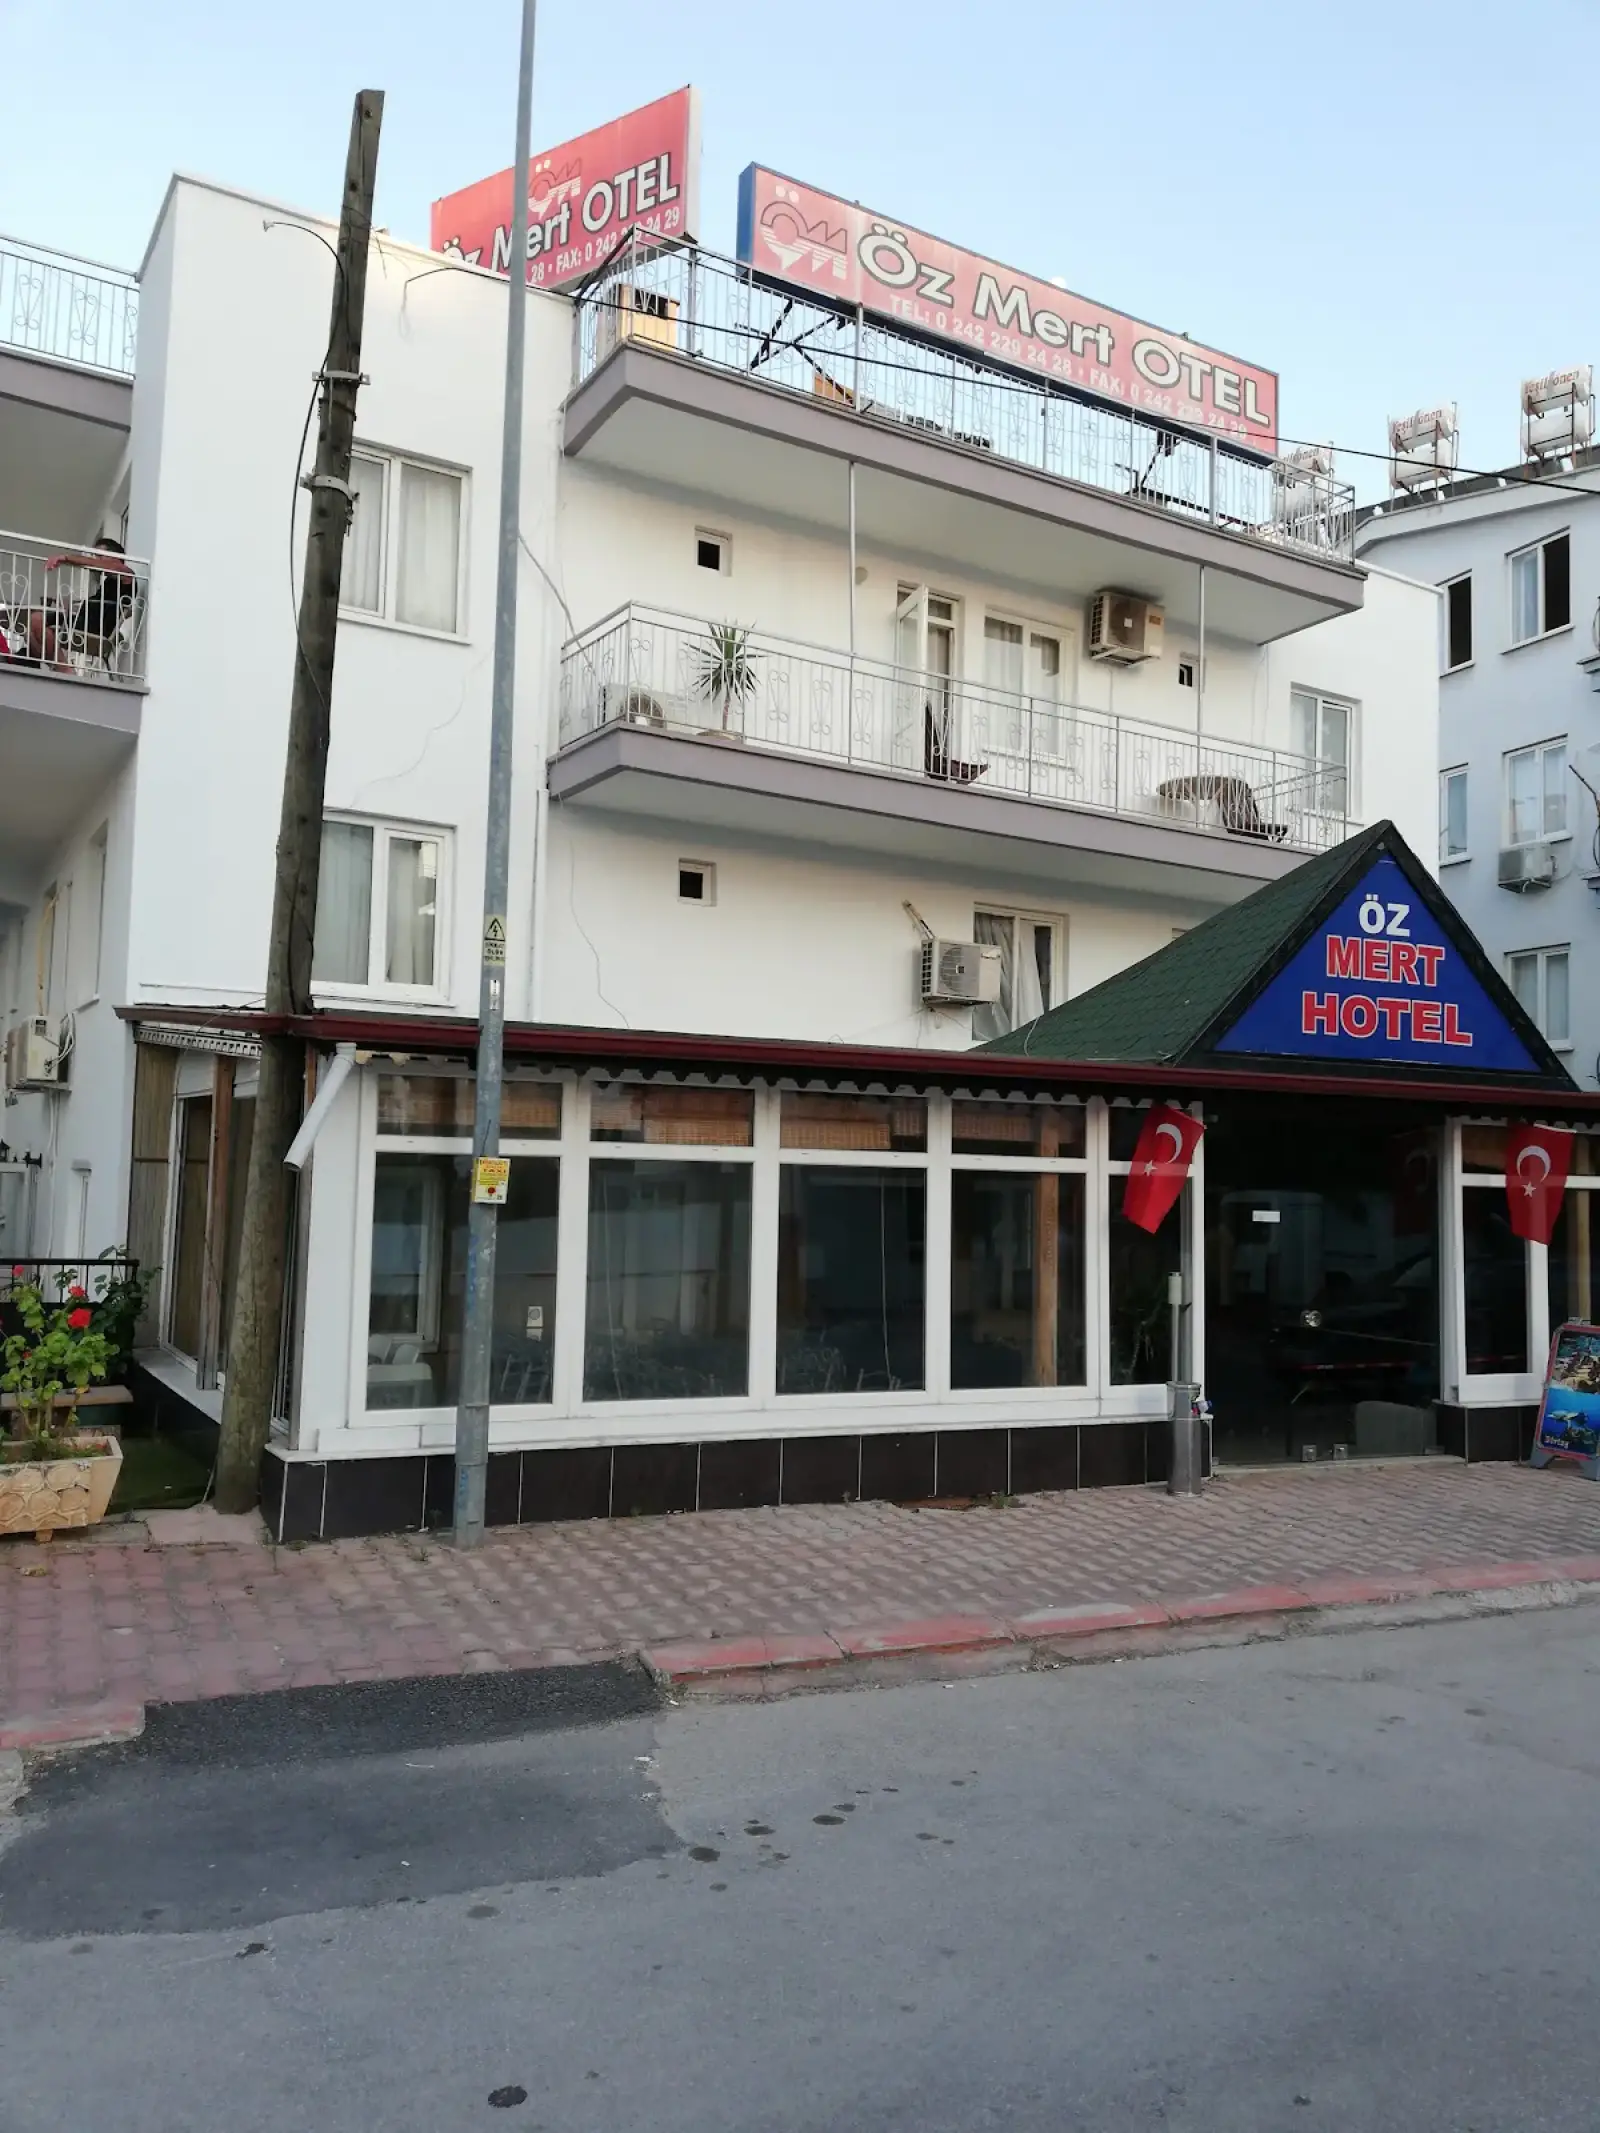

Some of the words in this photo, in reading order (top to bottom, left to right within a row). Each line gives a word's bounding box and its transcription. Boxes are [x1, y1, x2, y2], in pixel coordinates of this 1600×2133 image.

[491, 203, 572, 273] Mert
[581, 151, 680, 232] OTEL
[530, 262, 545, 284] 28
[555, 248, 582, 275] FAX:
[584, 243, 593, 262] 0
[595, 231, 617, 258] 242
[663, 206, 680, 231] 29
[857, 222, 955, 308] Öz
[971, 271, 1116, 366] Mert
[1131, 338, 1271, 428] OTEL
[888, 294, 931, 324] TEL:
[935, 311, 948, 329] 0
[952, 317, 985, 344] 242
[990, 330, 1022, 355] 229
[1027, 345, 1047, 367] 24
[1052, 355, 1073, 376] 28
[1089, 368, 1126, 396] FAX:
[1131, 383, 1140, 401] 0
[1144, 389, 1174, 413] 242
[1359, 894, 1411, 937] ÖZ
[1326, 935, 1445, 987] MERT
[1302, 991, 1473, 1047] HOTEL
